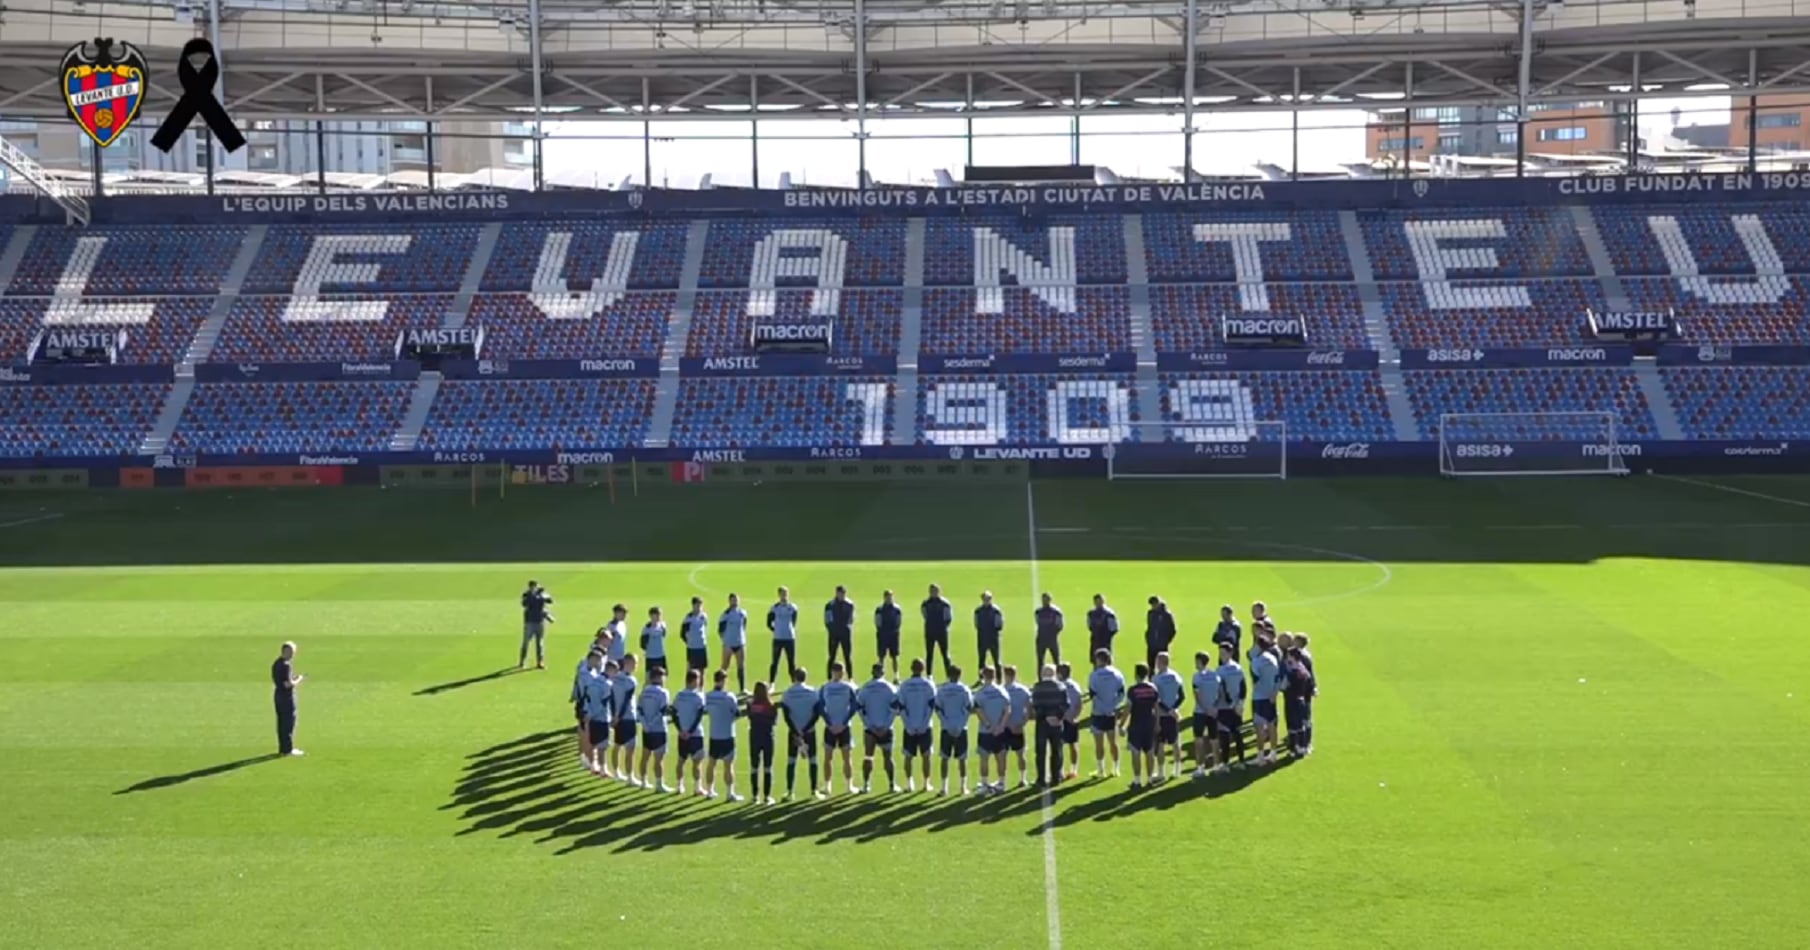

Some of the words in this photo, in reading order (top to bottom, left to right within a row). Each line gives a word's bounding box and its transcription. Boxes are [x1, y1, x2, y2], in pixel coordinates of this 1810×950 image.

[1559, 178, 1617, 194] CLUB
[1624, 175, 1716, 191] FUNDAT
[1722, 174, 1752, 190] EN
[784, 190, 917, 207] BENVINGUTS
[924, 190, 939, 205] A
[945, 188, 1035, 204] L'ESTADI
[1044, 187, 1117, 203] CIUTAT
[1124, 187, 1151, 202] DE
[1158, 182, 1265, 201] VALÈNCIA
[223, 197, 306, 212] L'EQUIP
[315, 197, 367, 211] DELS
[374, 194, 509, 211] VALENCIANS
[757, 324, 828, 340] macron
[1226, 319, 1300, 335] macron
[1548, 349, 1606, 361] macron
[580, 358, 636, 371] macron
[703, 357, 758, 370] AMSTEL
[973, 448, 1060, 459] LEVANTE
[1063, 447, 1091, 458] UD
[1581, 443, 1642, 456] macron
[557, 452, 614, 464] macron
[692, 451, 746, 463] AMSTEL
